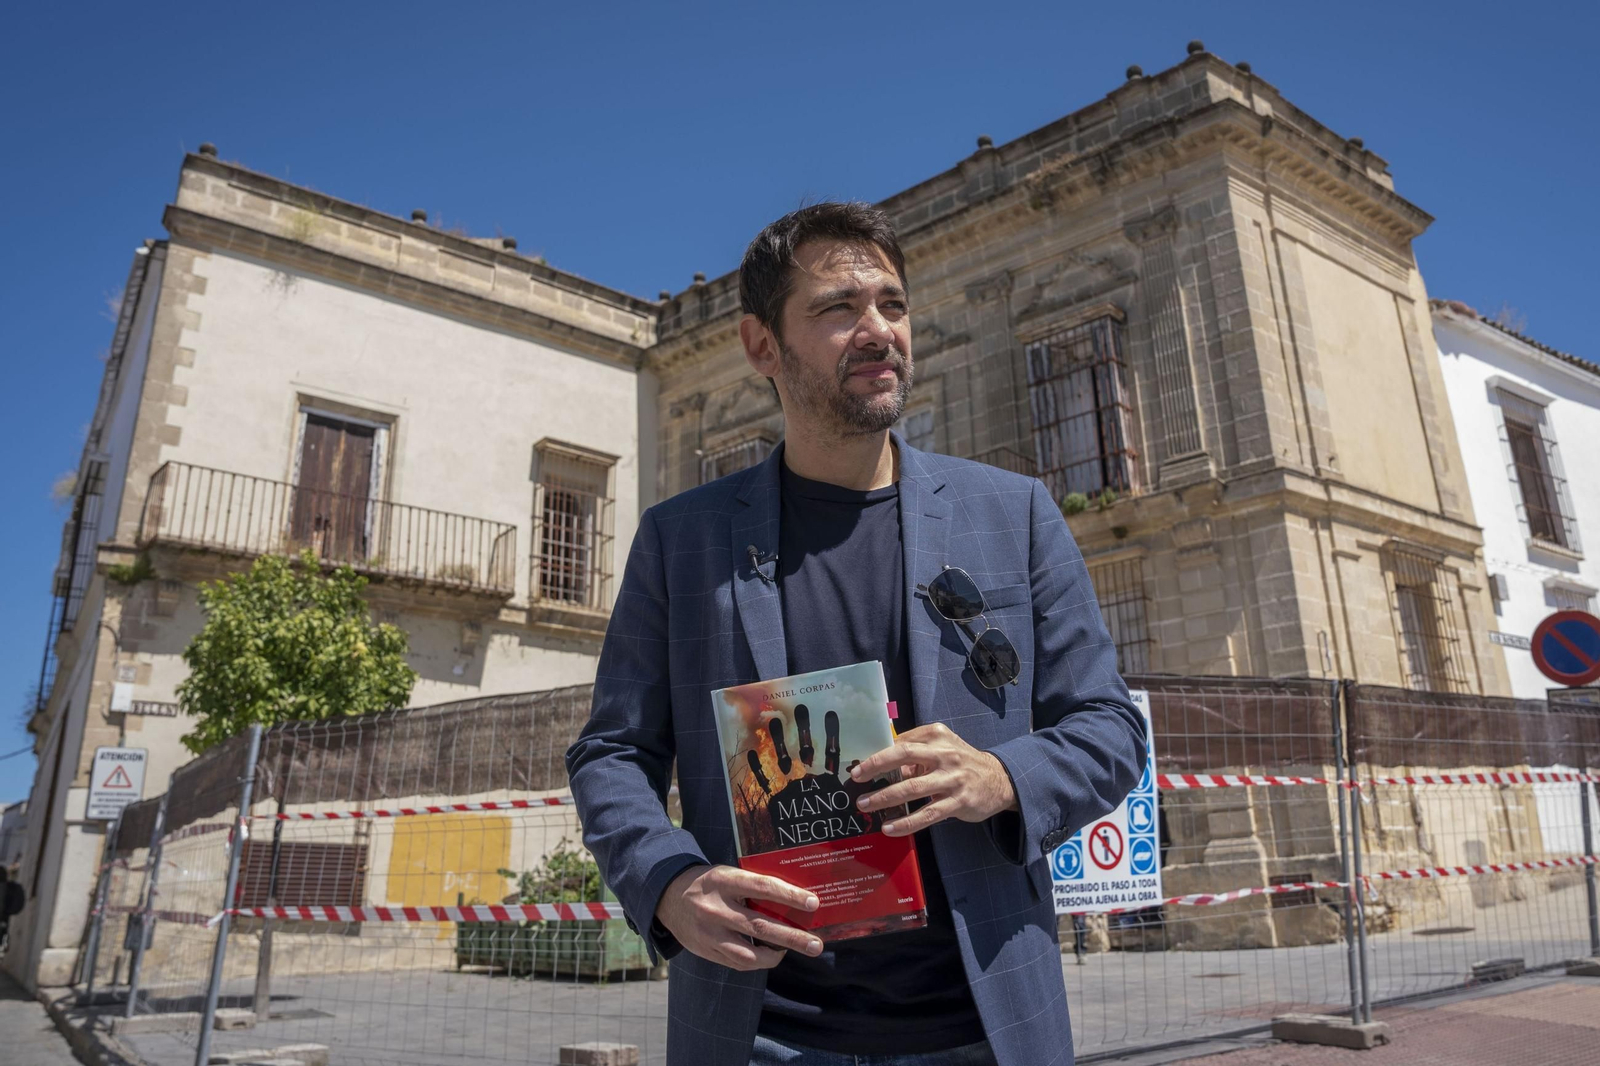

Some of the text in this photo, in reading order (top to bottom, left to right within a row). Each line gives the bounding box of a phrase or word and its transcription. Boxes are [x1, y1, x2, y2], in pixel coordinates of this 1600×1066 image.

[762, 682, 836, 702] DANIEL CORPAS
[800, 778, 821, 793] LA
[777, 790, 851, 821] MANO
[777, 814, 864, 847] NEGRA
[829, 847, 850, 856] sorprende
[1054, 878, 1157, 895] PROHIBIDO EL PASO A TODA
[1056, 890, 1158, 908] PERSONA AJENA A LA OBRA
